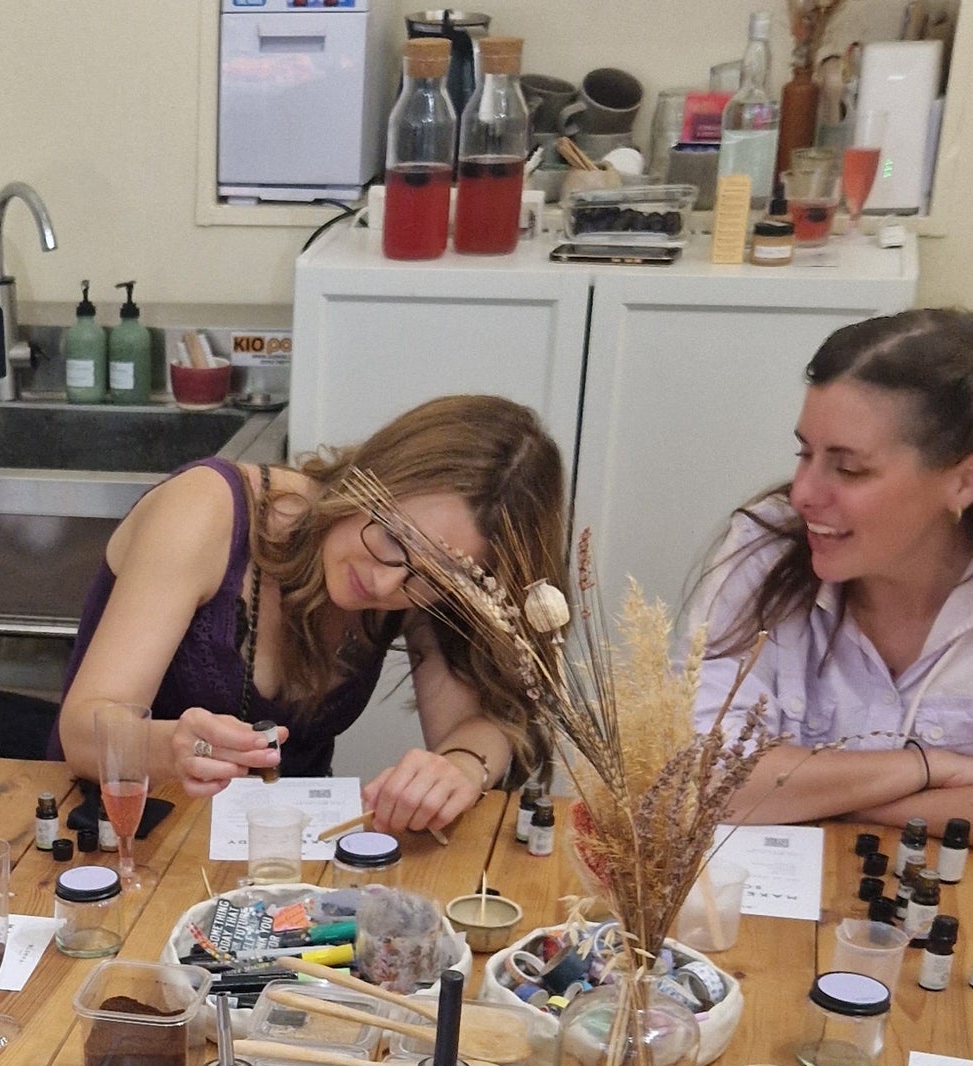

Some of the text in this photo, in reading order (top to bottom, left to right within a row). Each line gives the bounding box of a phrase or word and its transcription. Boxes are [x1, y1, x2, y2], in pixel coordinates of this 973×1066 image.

[234, 337, 264, 352] KIO
[225, 906, 239, 928] THAT
[259, 915, 274, 934] YOU
[218, 929, 233, 952] ODAY
